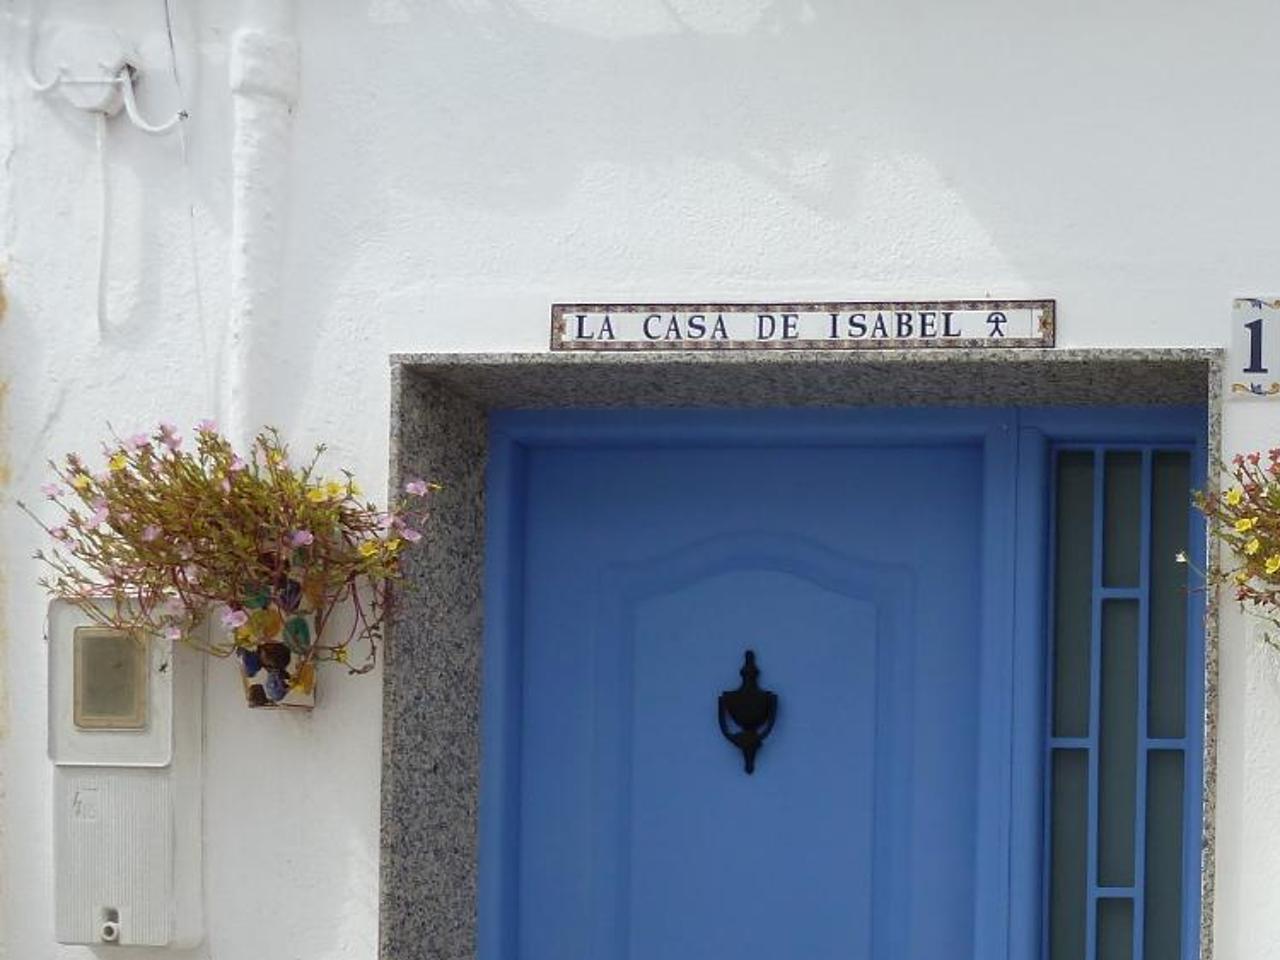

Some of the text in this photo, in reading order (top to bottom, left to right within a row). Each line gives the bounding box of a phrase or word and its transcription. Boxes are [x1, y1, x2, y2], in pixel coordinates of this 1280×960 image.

[575, 311, 962, 340] LA CASA DE ISABEL
